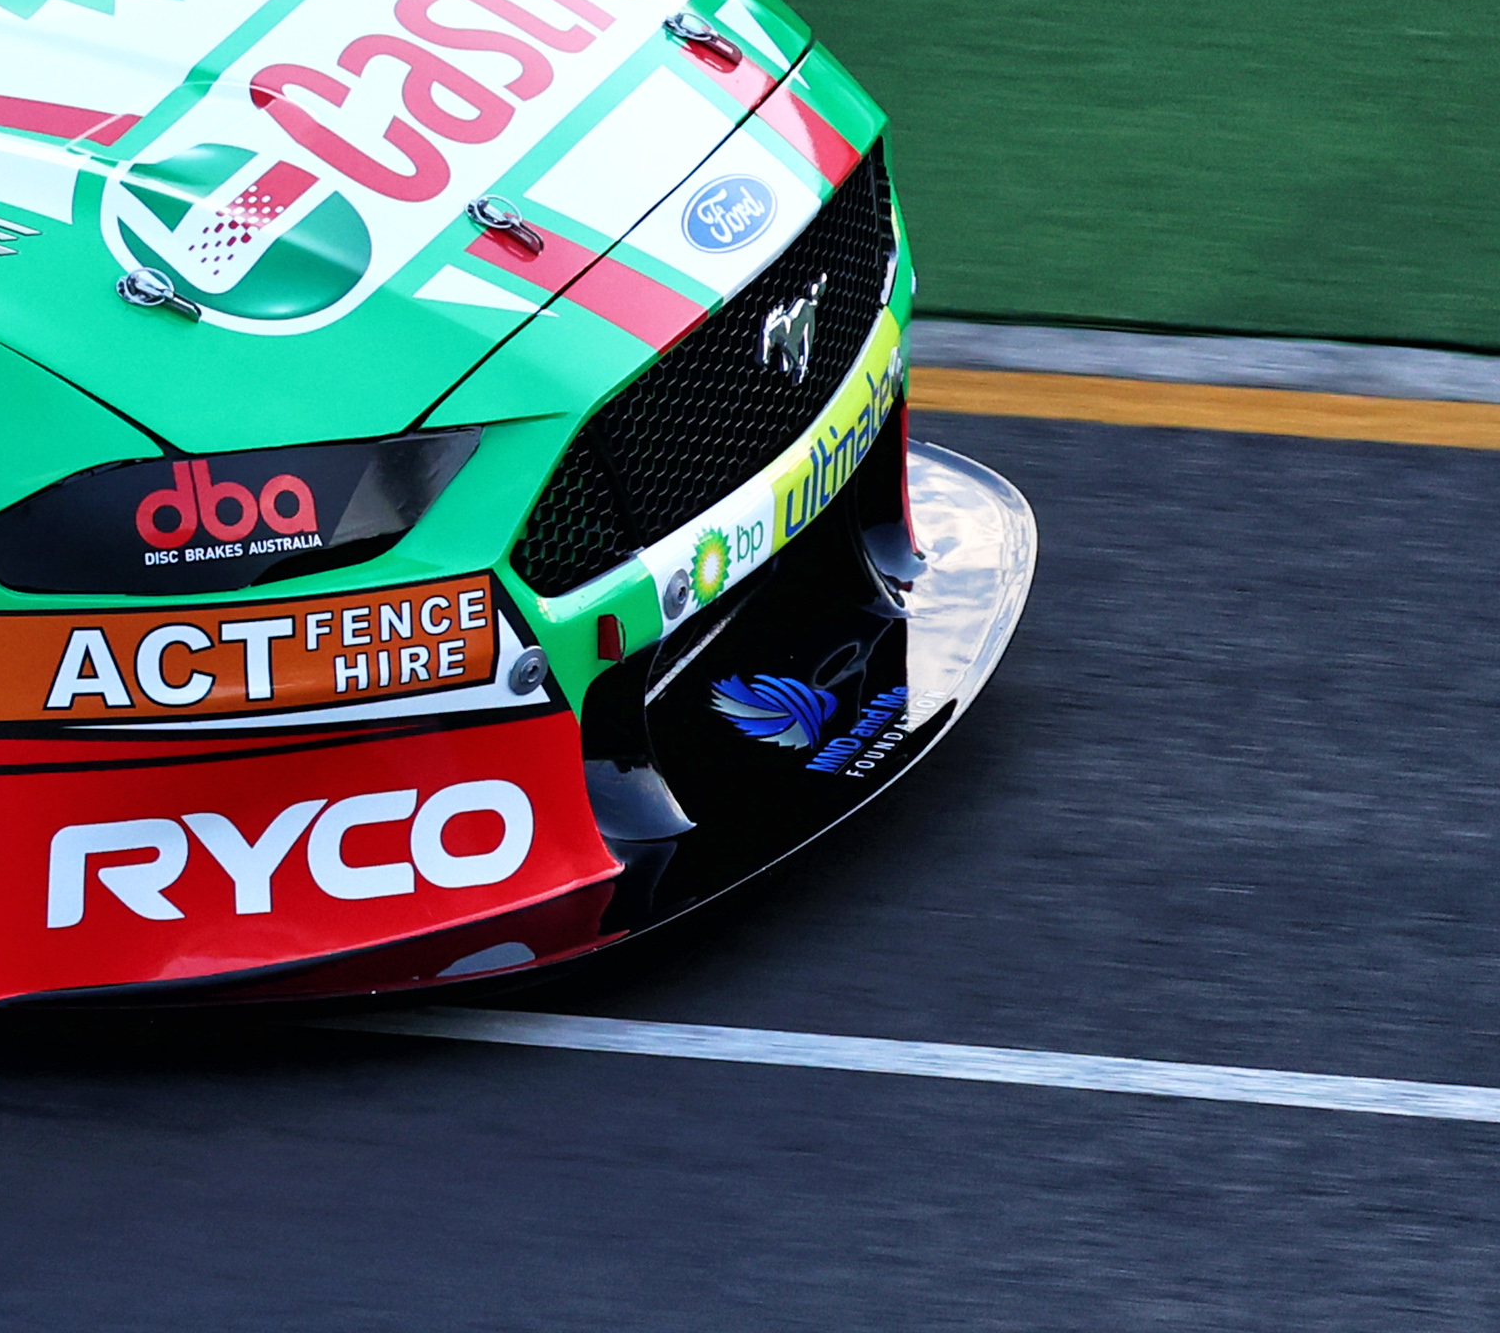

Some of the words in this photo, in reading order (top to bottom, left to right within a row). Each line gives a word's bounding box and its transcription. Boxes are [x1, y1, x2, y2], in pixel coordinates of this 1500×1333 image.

[700, 188, 766, 247] Ford
[785, 368, 892, 537] ultimate
[135, 459, 318, 549] dba
[145, 550, 178, 565] DISC
[185, 543, 243, 562] BRAKES
[249, 533, 322, 555] AUSTRALIA
[43, 617, 294, 711] ACT
[305, 588, 487, 650] FENCE
[335, 639, 467, 694] HIRE
[850, 709, 894, 737] and
[870, 686, 907, 709] Me
[806, 738, 862, 773] MND
[846, 690, 947, 778] FOUNDATION
[46, 778, 534, 928] RYCO
